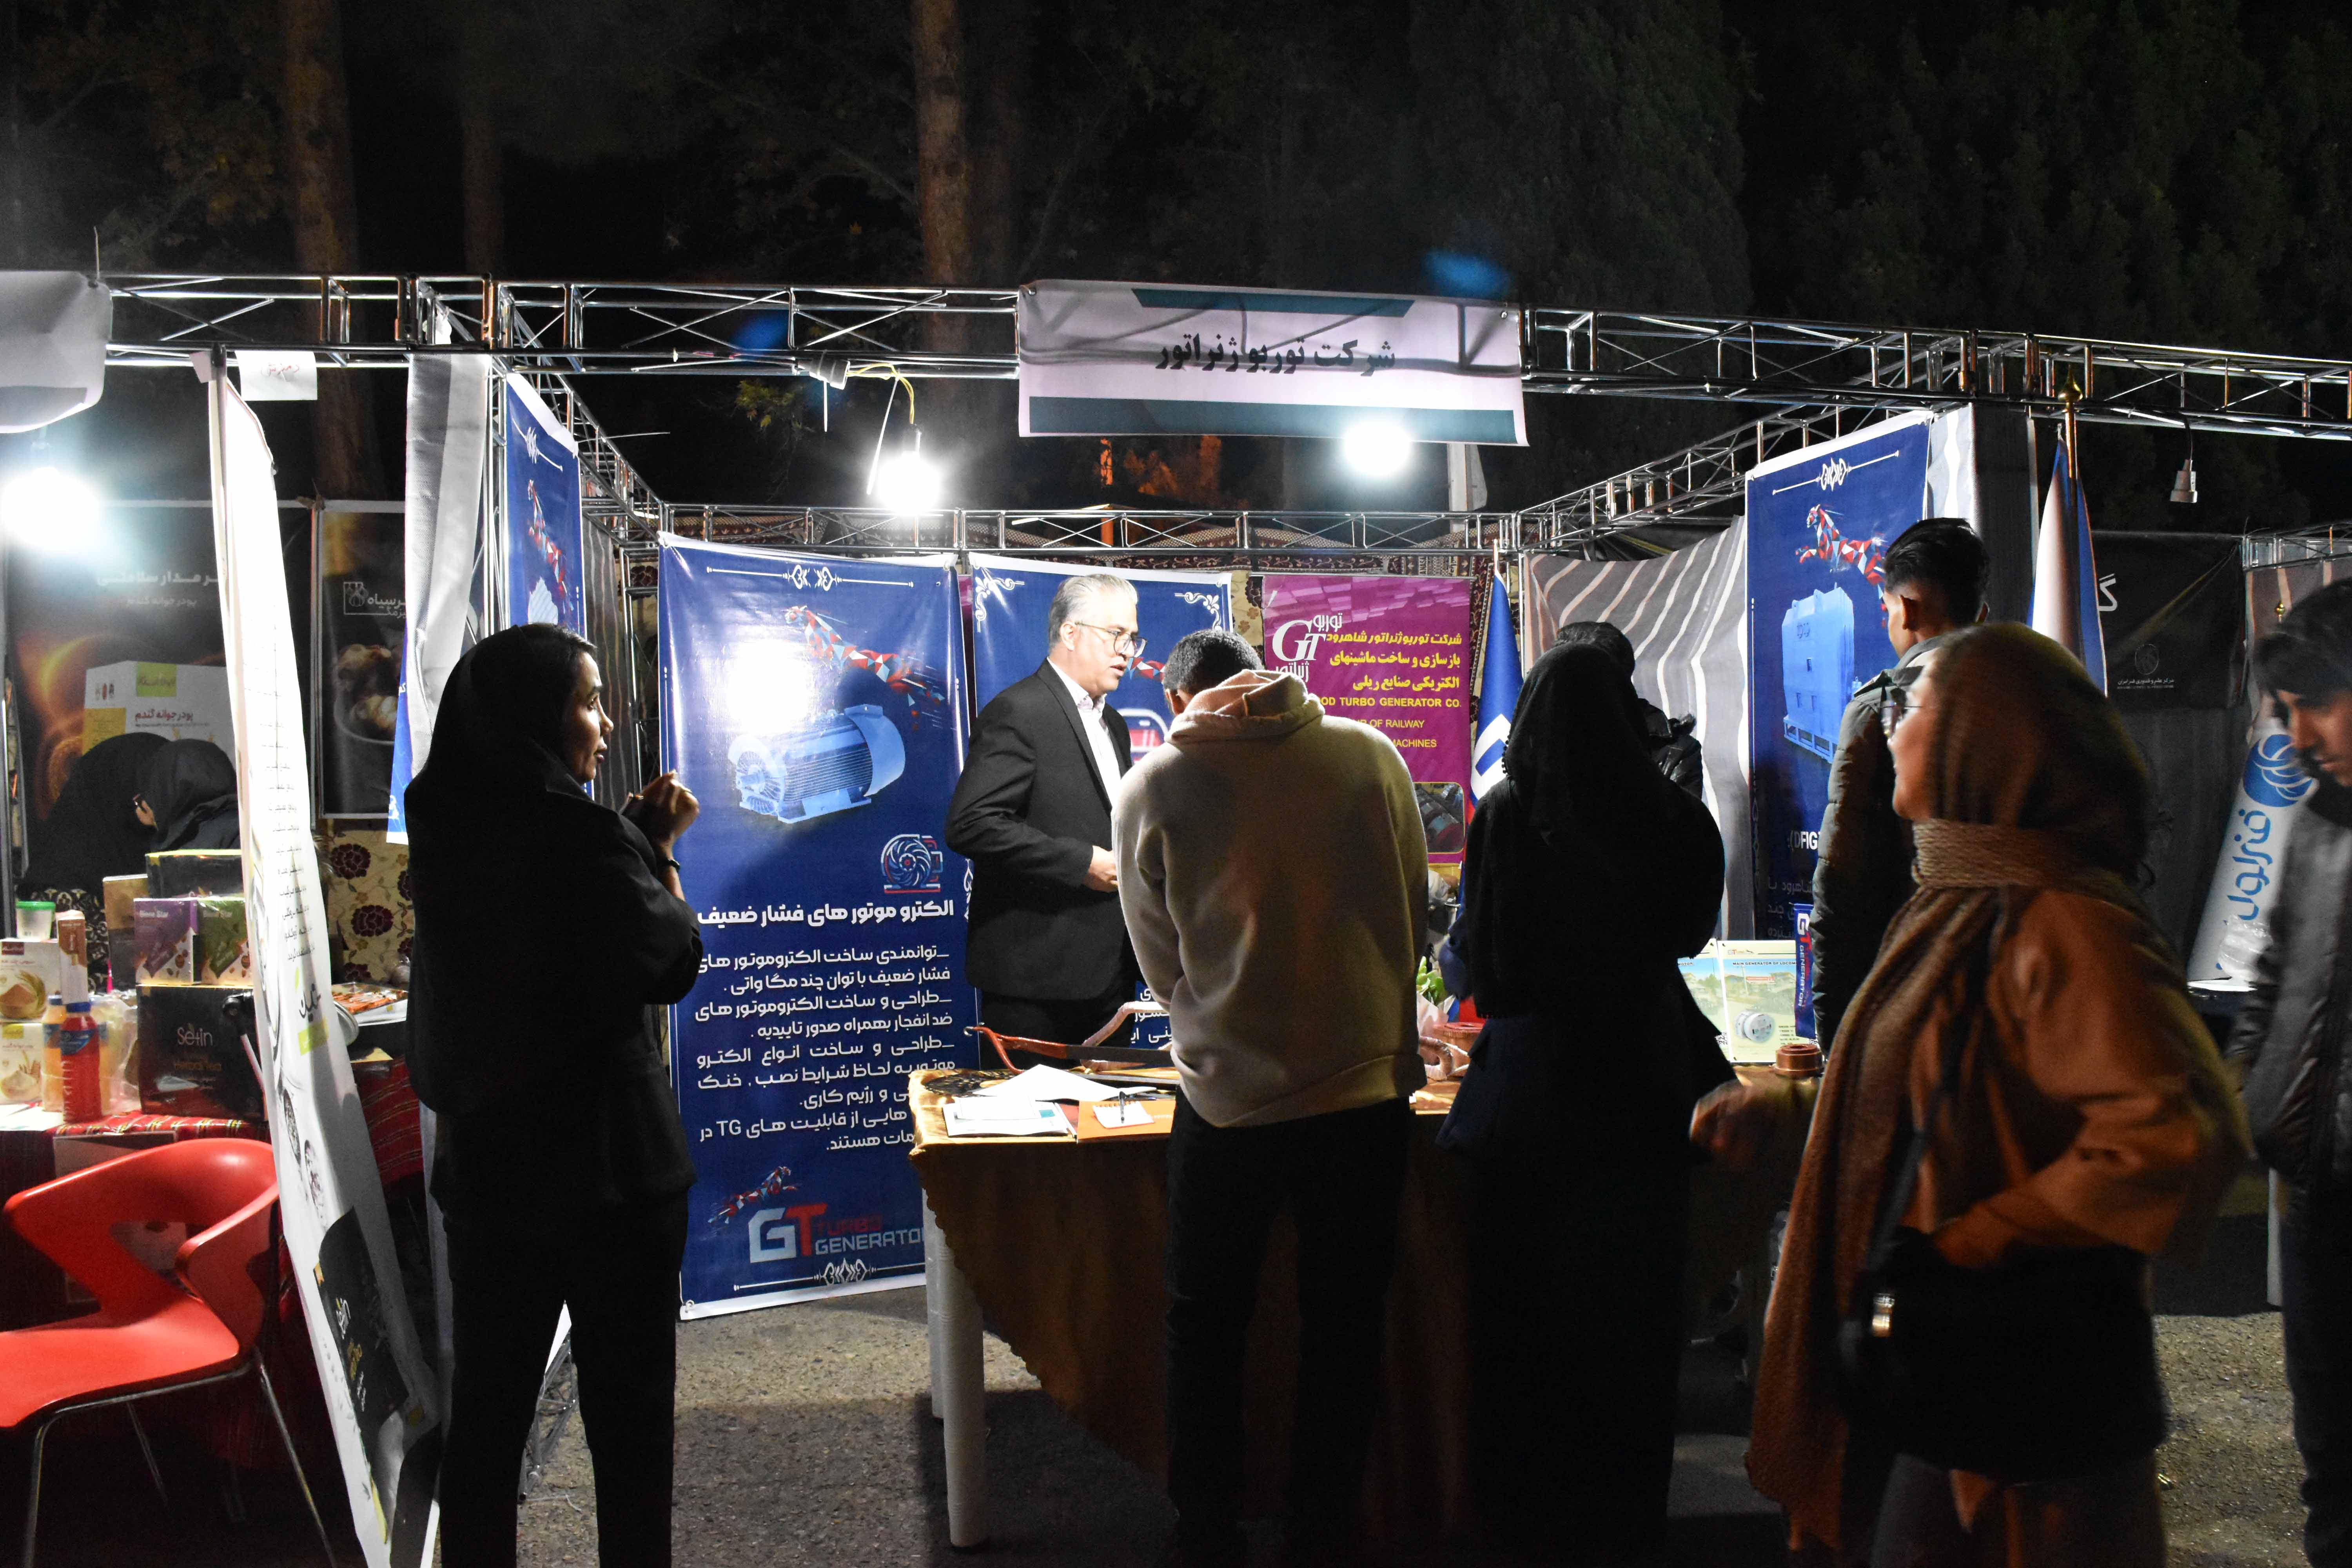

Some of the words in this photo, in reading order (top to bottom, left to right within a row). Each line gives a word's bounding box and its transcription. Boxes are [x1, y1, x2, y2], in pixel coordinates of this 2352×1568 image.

[1314, 339, 1396, 377] شرکت
[1312, 613, 1342, 632] توربو
[1272, 619, 1327, 662] GT
[1326, 630, 1367, 644] شاهرود
[1368, 631, 1428, 645] توربوژنراتور
[1430, 632, 1462, 645] شرکت
[1330, 650, 1376, 666] ماشینهای
[1377, 652, 1409, 664] ساخت
[1412, 657, 1418, 668] و
[1276, 661, 1309, 682] ژنراتو
[1352, 675, 1380, 690] ریلی
[1381, 675, 1410, 690] صنایع
[1412, 676, 1460, 691] الکتریکی
[1339, 697, 1376, 706] TURBO
[1379, 697, 1442, 707] GENERATOR
[1445, 699, 1462, 708] CO.
[156, 708, 176, 722] جوانه
[1370, 719, 1383, 728] OF
[1385, 720, 1425, 728] RAILWAY
[697, 906, 758, 929] ضعیف
[760, 903, 804, 927] فشار
[808, 903, 848, 927] های
[851, 903, 897, 924] موتور
[900, 900, 954, 923] الکترو
[698, 953, 731, 973] های
[733, 949, 821, 971] الکتروموتور
[823, 947, 873, 963] ساخت
[766, 973, 798, 989] مگا
[800, 974, 824, 991] چند
[826, 971, 855, 991] توان
[857, 971, 866, 987] با
[869, 969, 915, 986] ضعیف
[918, 967, 950, 985] فشار
[730, 976, 763, 995] واتی
[735, 996, 823, 1018] الکتروموتور
[825, 994, 875, 1009] ساخت
[880, 996, 889, 1010] و
[695, 1002, 733, 1022] های
[932, 1012, 953, 1025] ضد
[757, 1020, 803, 1040] تاییدیه
[806, 1022, 841, 1038] صدور
[844, 1017, 891, 1034] بهمراه
[894, 1013, 929, 1032] انفجار
[761, 1044, 800, 1066] انواع
[809, 1041, 864, 1057] ساخت
[873, 1043, 882, 1056] و
[696, 1047, 751, 1069] الکترو
[802, 1064, 849, 1083] شرایط
[853, 1061, 890, 1077] لحاظ
[697, 1073, 742, 1089] خنک
[755, 1069, 799, 1088] نصب
[846, 1085, 873, 1106] رژیم
[879, 1089, 887, 1102] و
[790, 1112, 846, 1131] قابلیت
[851, 1110, 858, 1128] از
[863, 1107, 907, 1128] هایی
[700, 1128, 713, 1142] در
[716, 1119, 742, 1136] TG
[746, 1118, 786, 1139] های
[748, 1202, 828, 1263] GT
[815, 1228, 925, 1255] GENERATO
